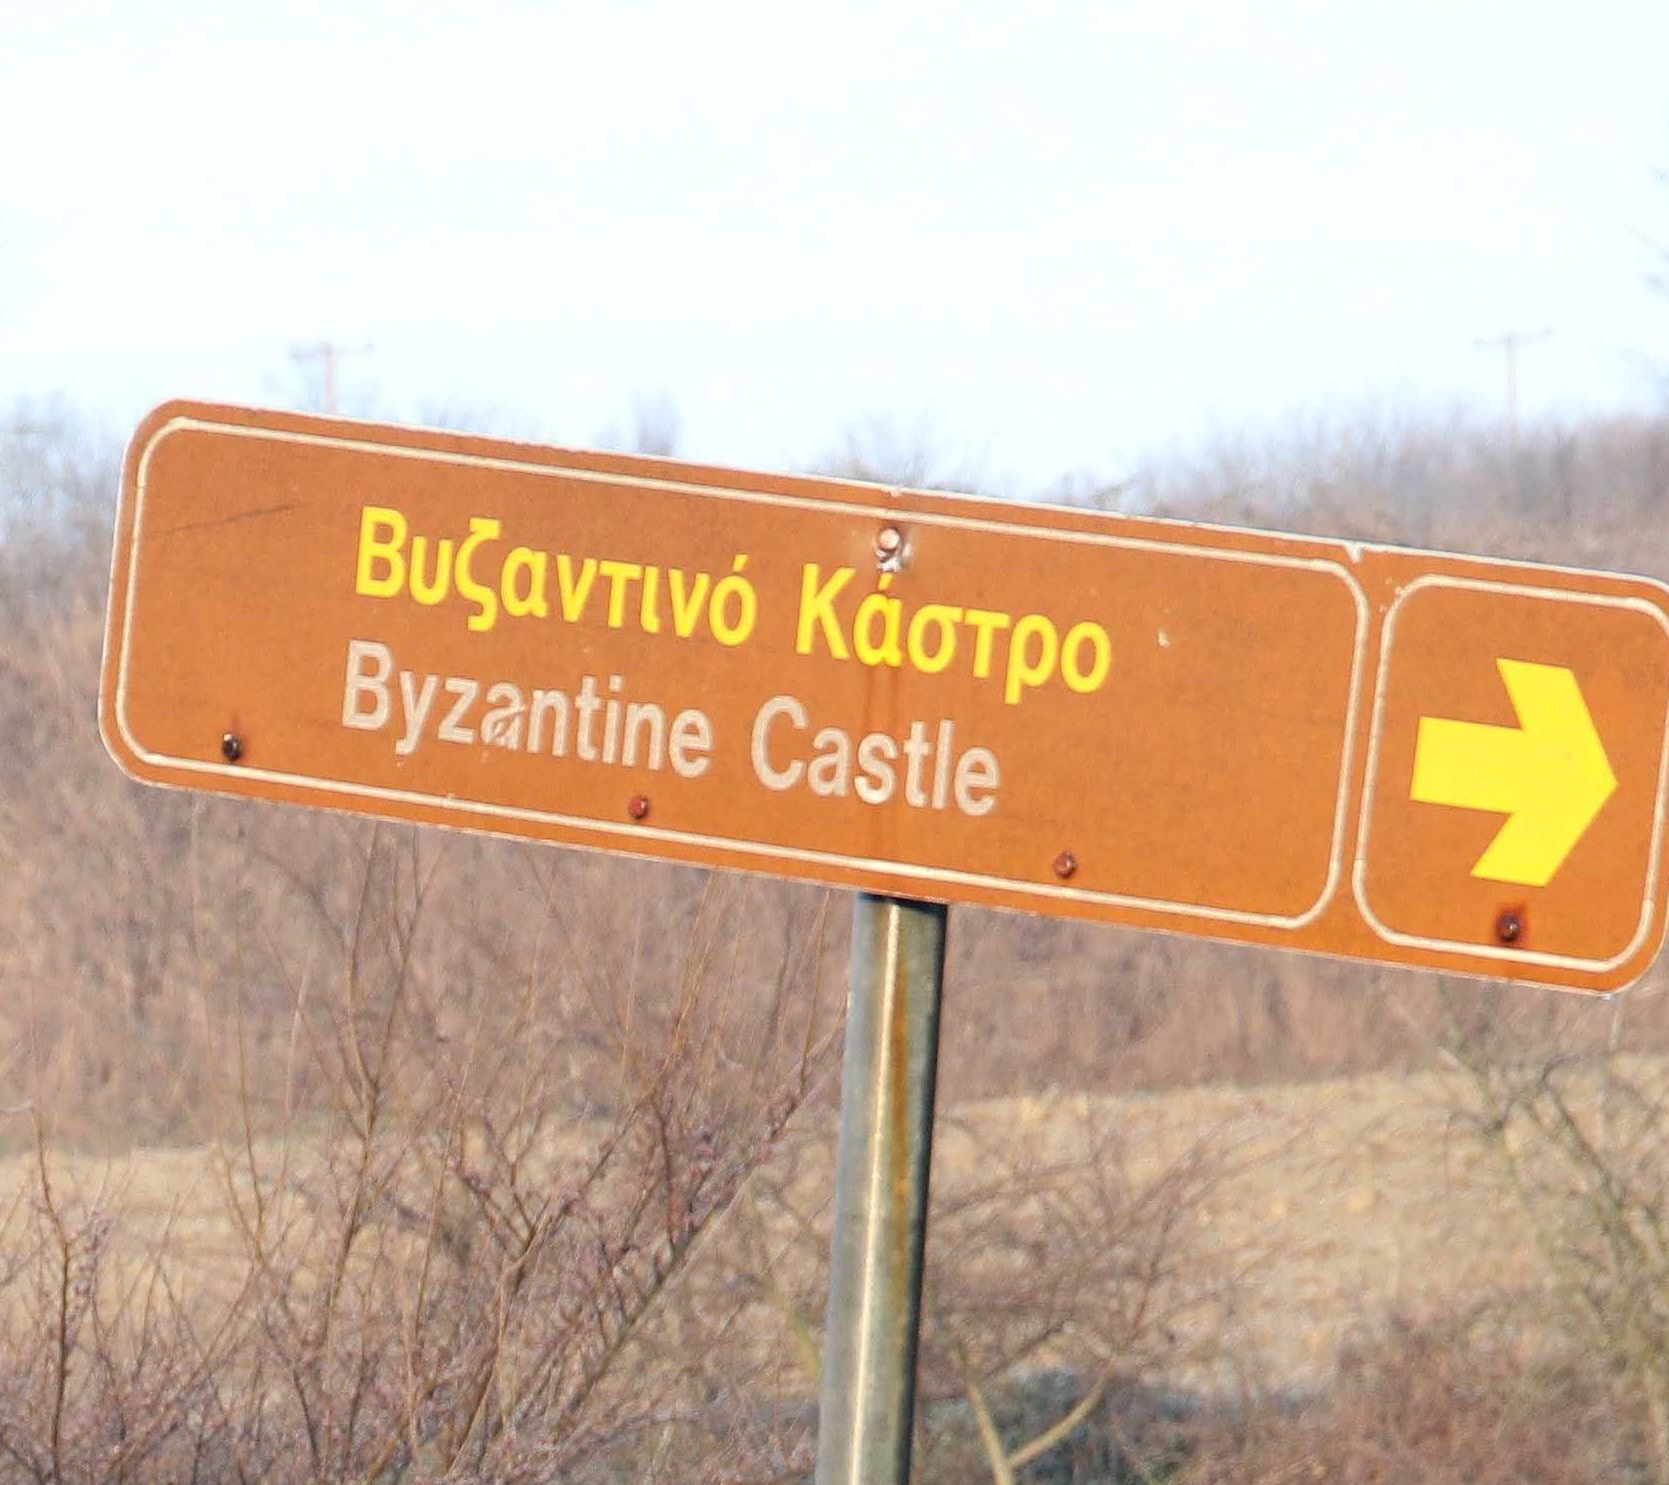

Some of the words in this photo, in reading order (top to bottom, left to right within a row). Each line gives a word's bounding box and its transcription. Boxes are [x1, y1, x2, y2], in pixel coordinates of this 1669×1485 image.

[354, 505, 758, 646] Βυζαντινό
[795, 562, 1113, 705] Κάστρο
[341, 639, 715, 778] Byzantine
[750, 695, 1002, 818] Castle
